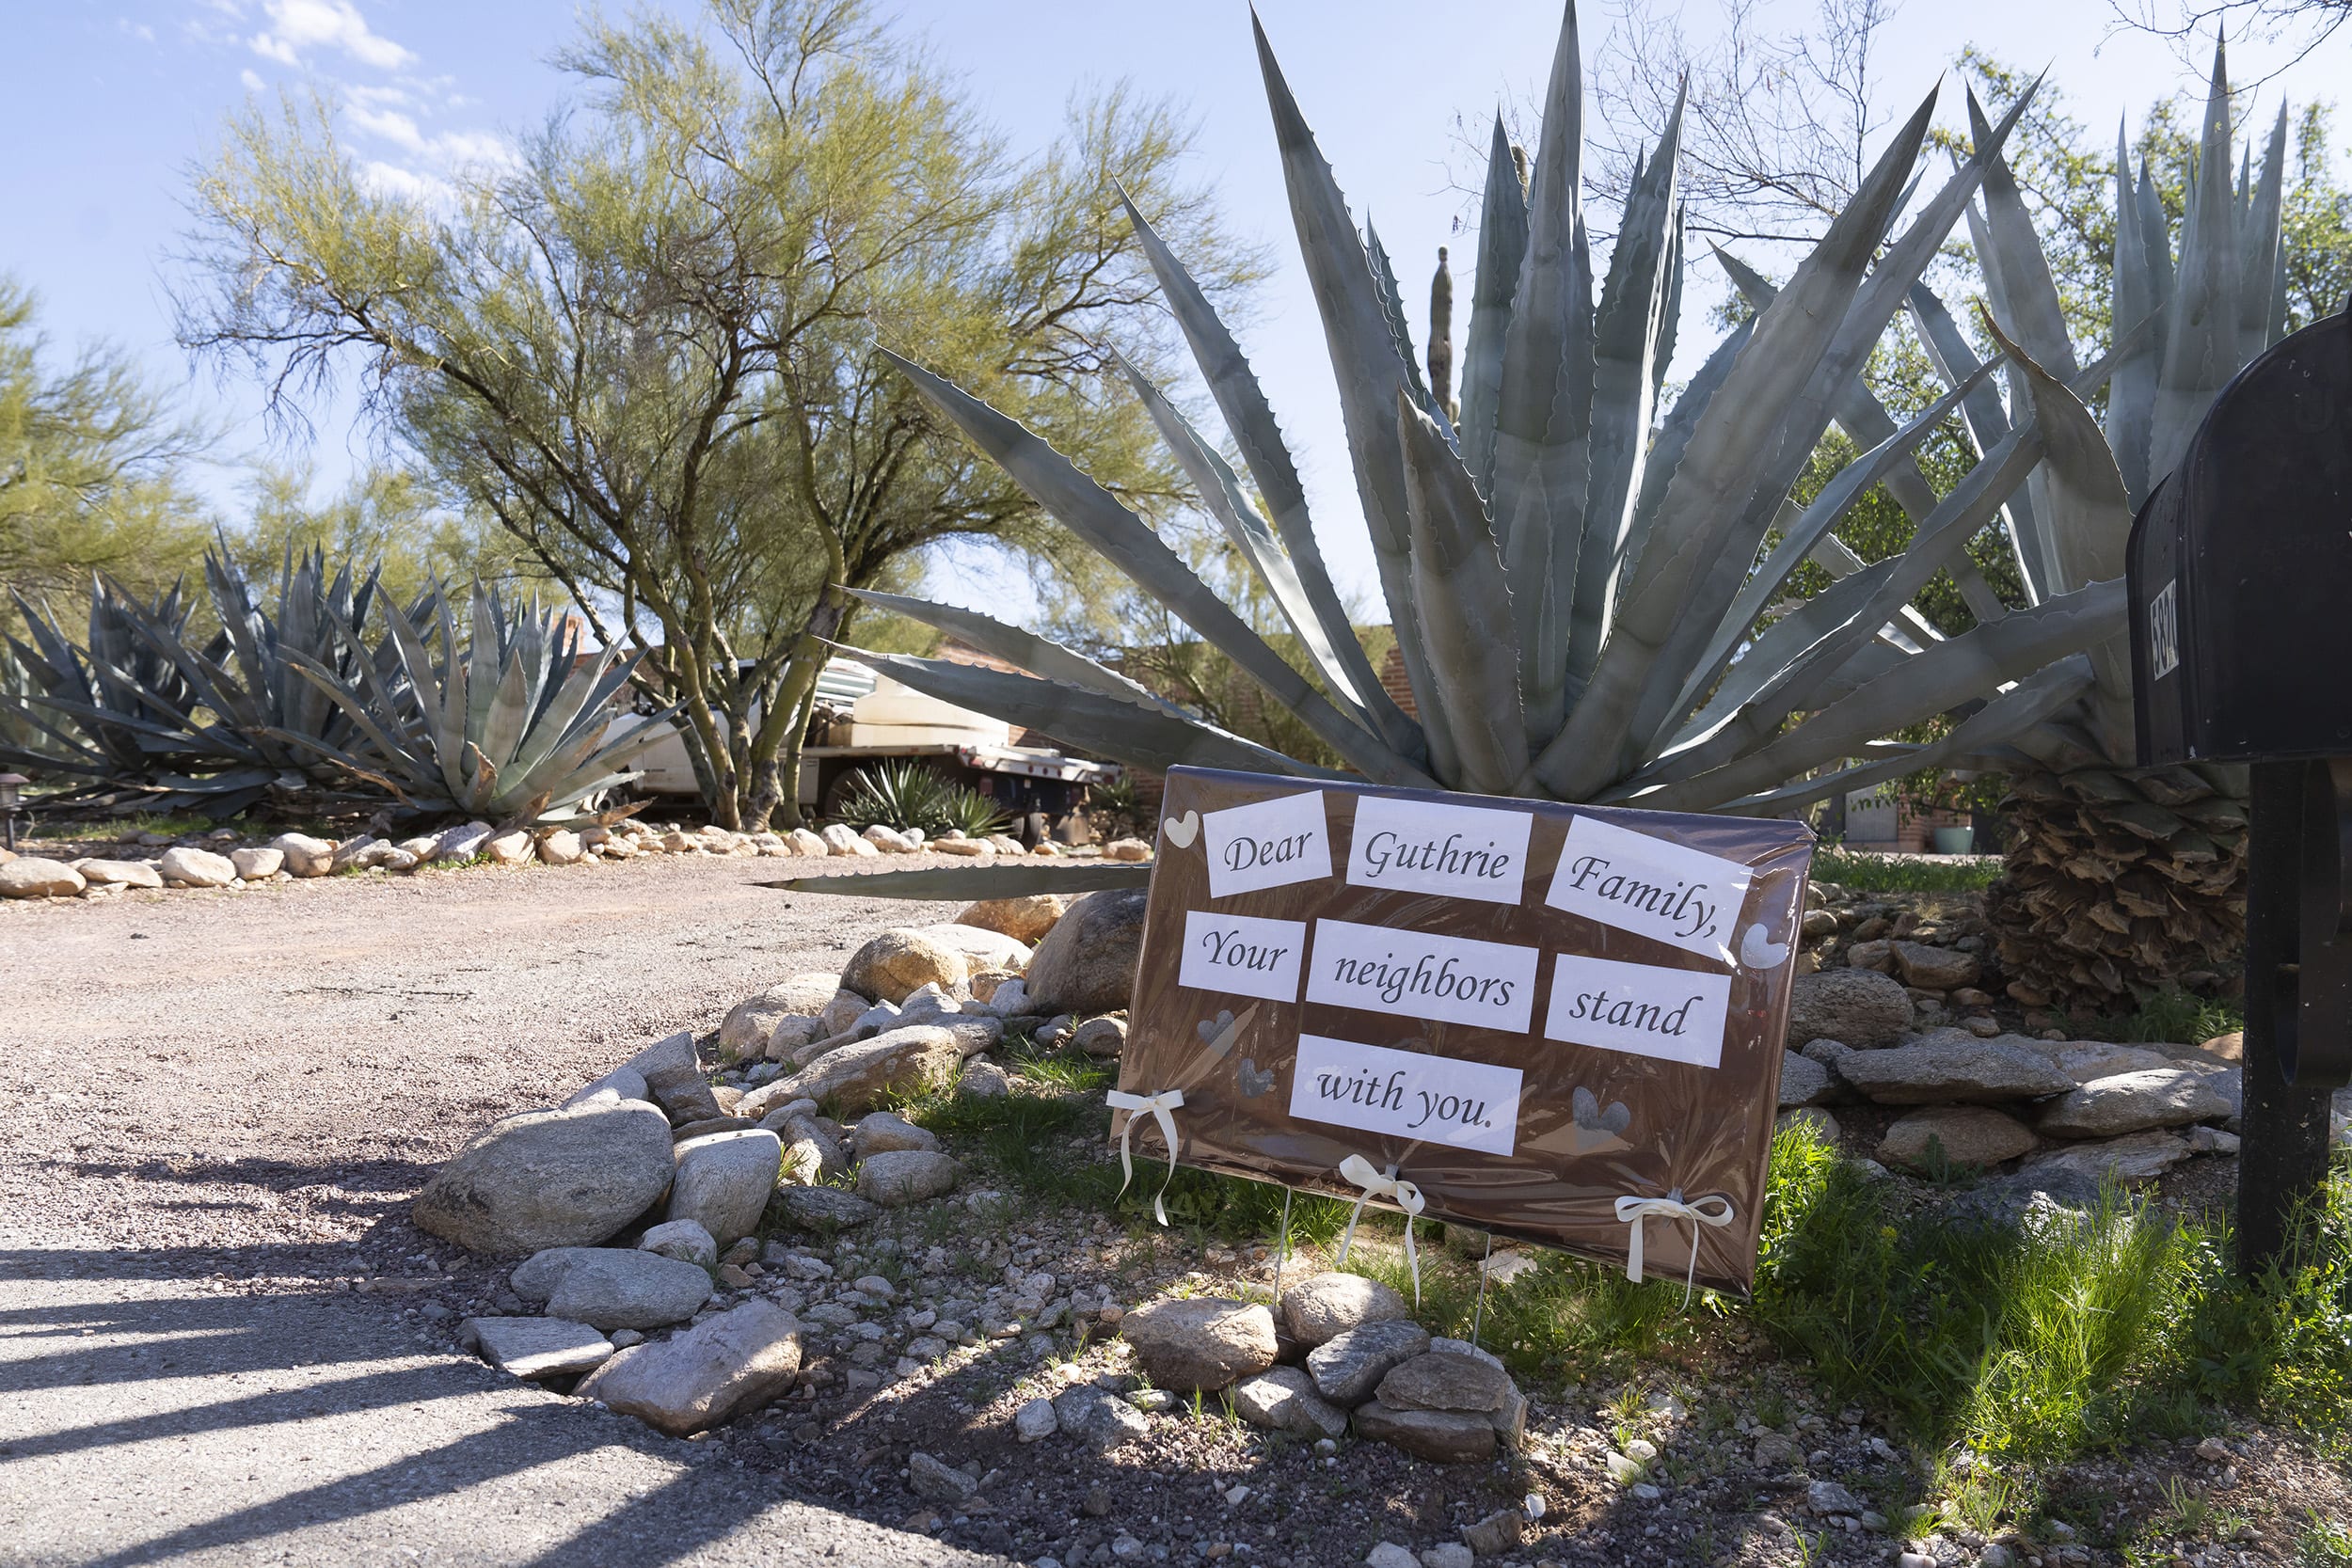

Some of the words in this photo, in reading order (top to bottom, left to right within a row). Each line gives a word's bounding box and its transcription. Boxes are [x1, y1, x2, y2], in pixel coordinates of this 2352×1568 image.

[1224, 832, 1313, 872] Dear
[1365, 832, 1510, 879] Guthrie
[1569, 855, 1718, 939] Family,
[1202, 929, 1289, 972] Your
[1333, 953, 1516, 1006] neighbors
[1568, 991, 1704, 1037] stand
[1316, 1069, 1406, 1112] with
[1407, 1090, 1491, 1129] you.
